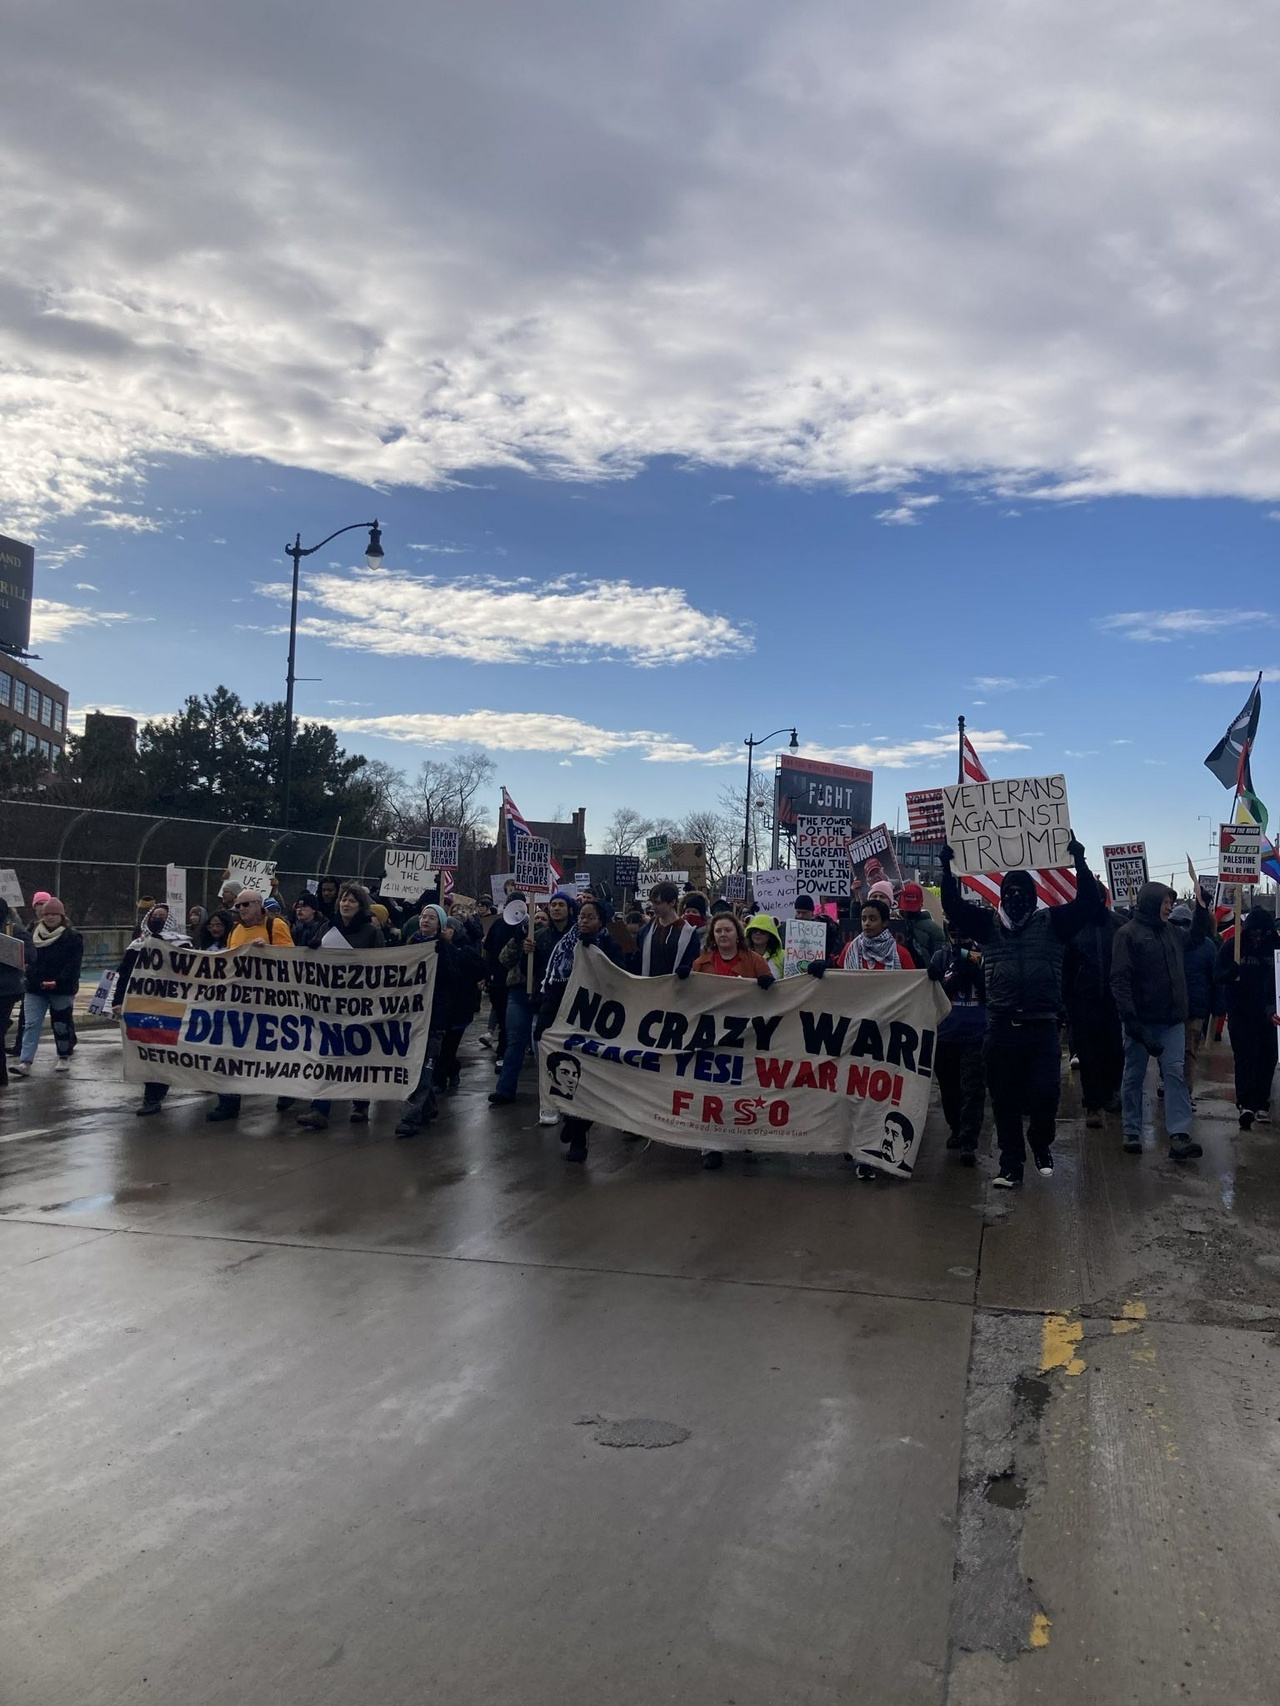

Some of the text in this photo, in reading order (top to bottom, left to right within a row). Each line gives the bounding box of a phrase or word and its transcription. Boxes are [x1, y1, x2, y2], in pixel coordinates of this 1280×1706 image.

[809, 782, 853, 810] FIGHT
[944, 777, 1064, 809] VETERANS
[798, 817, 852, 827] THE POWER
[951, 803, 1065, 836] AGAINST
[806, 826, 846, 836] OF THE
[518, 841, 549, 853] DEPORT
[800, 835, 850, 847] PEOPLE
[431, 850, 456, 858] DEPORT
[812, 847, 847, 858] GREATE
[850, 836, 888, 864] WANTED
[950, 828, 1070, 870] TRUMP
[1105, 845, 1143, 857] FUCK ICE
[387, 852, 434, 871] UPHOL
[517, 851, 548, 863] ATIONS
[1223, 856, 1255, 864] PALESTINE
[231, 857, 261, 872] WEAK
[797, 859, 850, 868] THAN THE
[1113, 861, 1140, 870] UNITE
[401, 871, 419, 881] THE
[517, 865, 548, 876] DEPORT
[797, 869, 850, 879] PEOPLE IN
[243, 876, 263, 888] USE
[516, 875, 548, 885] ACIONES
[638, 873, 685, 884] HANG ALL
[384, 883, 400, 892] 4TH
[777, 888, 796, 896] NOT
[797, 880, 847, 895] POWER
[790, 920, 824, 937] FROGS
[787, 947, 824, 961] FACISM
[135, 948, 427, 989] NO WAR WITH VENEZUELA
[127, 977, 193, 999] MONEY
[194, 984, 227, 1001] FOR
[304, 992, 331, 1013] NOT
[336, 998, 373, 1016] FOR
[380, 994, 424, 1014] WAR
[184, 1008, 411, 1057] DIVEST NOW
[566, 986, 935, 1078] NO CRAZY WAR!
[138, 1046, 409, 1085] DETROIT ANTI-WAR COMMITTEE
[564, 1034, 904, 1107] PEACE YES! WAR NO!
[654, 1113, 808, 1137] Freedom Road Socialist Organization
